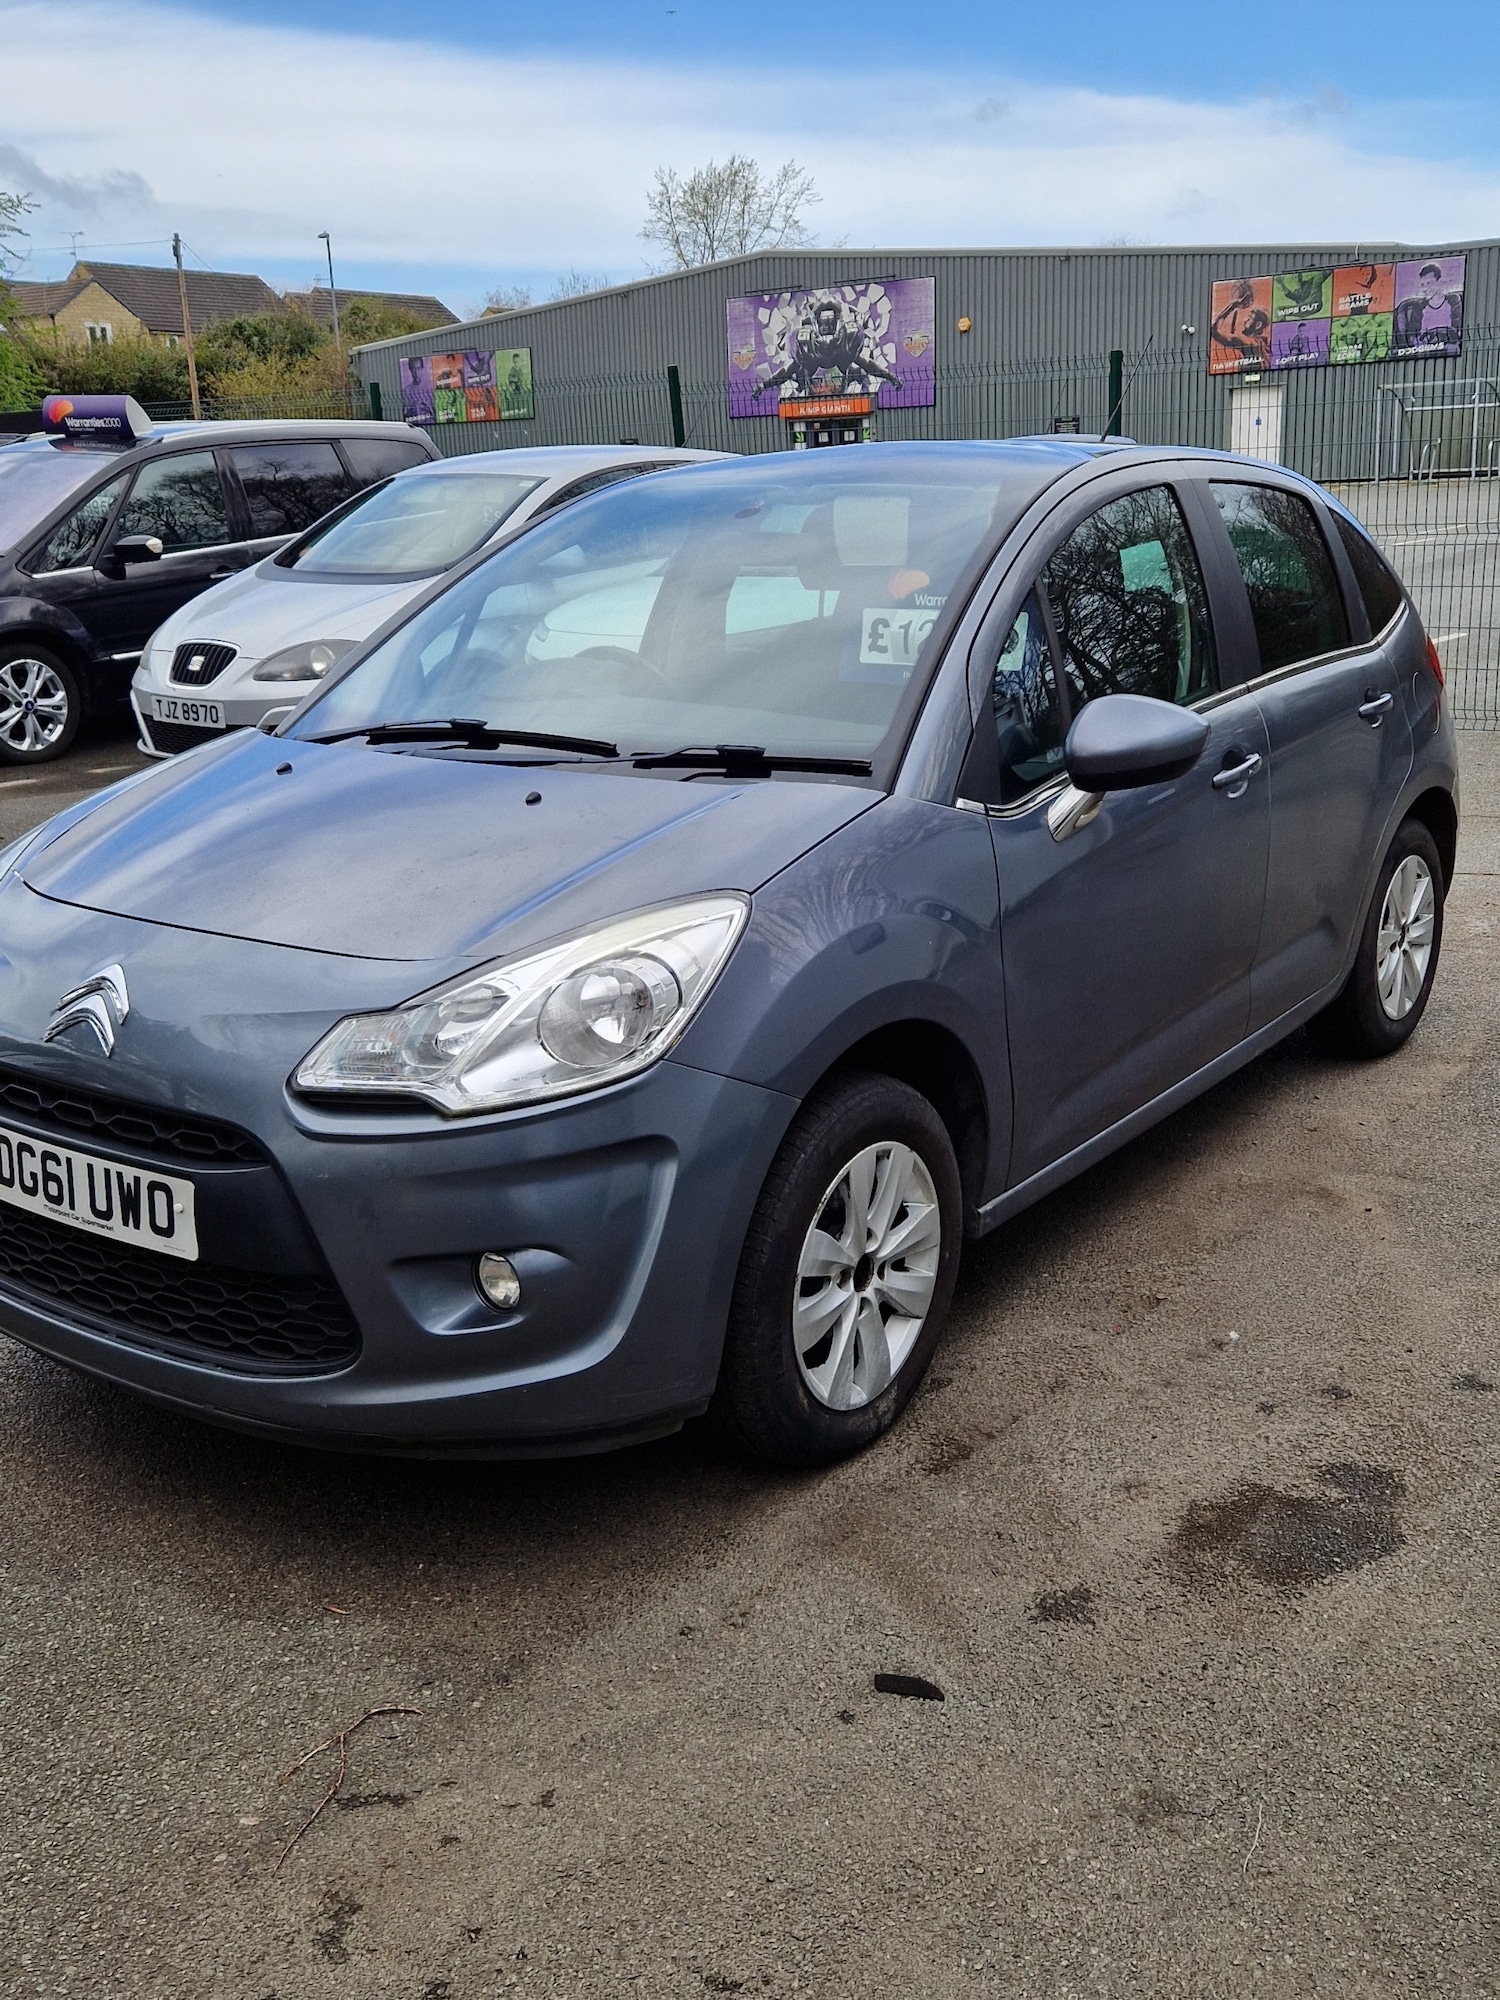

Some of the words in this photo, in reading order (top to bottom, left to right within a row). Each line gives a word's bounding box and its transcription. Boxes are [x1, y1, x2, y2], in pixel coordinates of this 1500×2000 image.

[1277, 306, 1299, 317] WIPE
[1300, 303, 1319, 312] OUT
[156, 699, 179, 720] TJZ
[182, 702, 219, 724] 8970
[0, 1134, 76, 1211] DG61
[86, 1162, 175, 1239] UWO
